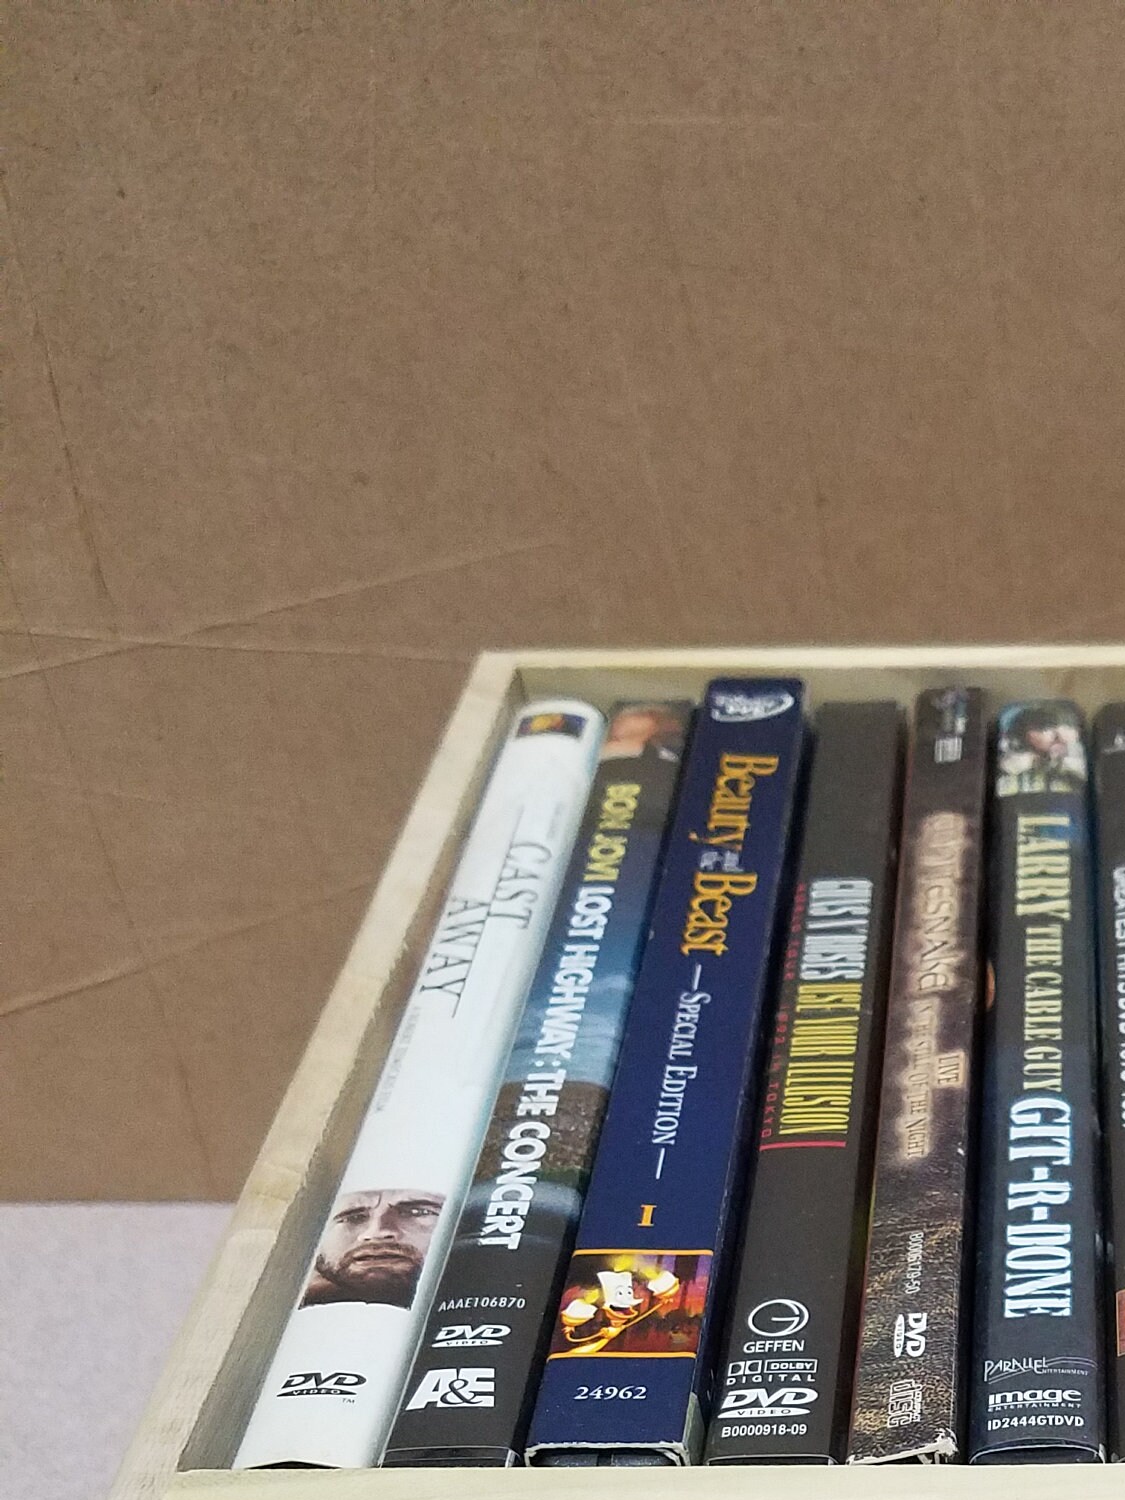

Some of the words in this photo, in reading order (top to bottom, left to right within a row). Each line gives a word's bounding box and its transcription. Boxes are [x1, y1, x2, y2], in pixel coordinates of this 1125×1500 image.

[599, 783, 642, 829] BON
[688, 752, 779, 850] Beauty
[583, 833, 628, 882] JOVI
[1016, 814, 1071, 920] LARRY
[488, 842, 551, 930] CAST
[567, 886, 615, 940] LOST
[680, 871, 757, 956] Beast
[420, 899, 491, 1001] AWAY
[800, 935, 867, 980] ROSES
[1026, 924, 1062, 967] THE
[796, 983, 863, 1013] USE
[1024, 971, 1062, 1040] CABLE
[669, 991, 711, 1060] SPECIAL
[790, 1015, 859, 1057] YOUR
[910, 1073, 930, 1092] OF
[937, 1055, 960, 1085] LIVE
[1023, 1046, 1062, 1092] GUY
[517, 1068, 567, 1116] THE
[652, 1065, 697, 1145] EDITION
[761, 1082, 780, 1139] TOKYO
[779, 1061, 854, 1135] ILLUSION
[906, 1091, 929, 1114] THE
[904, 1118, 927, 1160] NIGHT
[477, 1121, 550, 1250] CONCERT
[1003, 1098, 1072, 1319] GIT-R-DONE
[438, 1297, 526, 1312] AAAE106870
[435, 1324, 512, 1341] DVD
[743, 1339, 805, 1354] GEFFEN
[904, 1312, 927, 1358] DVD
[281, 1372, 367, 1389] DVD
[726, 1374, 816, 1386] DIGITAL
[770, 1361, 814, 1371] DOLBY
[405, 1367, 495, 1411] A&E
[574, 1386, 647, 1400] 24962
[721, 1387, 819, 1410] DVD
[987, 1403, 1082, 1412] ENTERTAINMENT
[989, 1389, 1082, 1405] image
[721, 1423, 808, 1438] B0000918-09
[737, 1408, 792, 1416] VIDEO
[987, 1415, 1085, 1431] ID2444GTDVD
